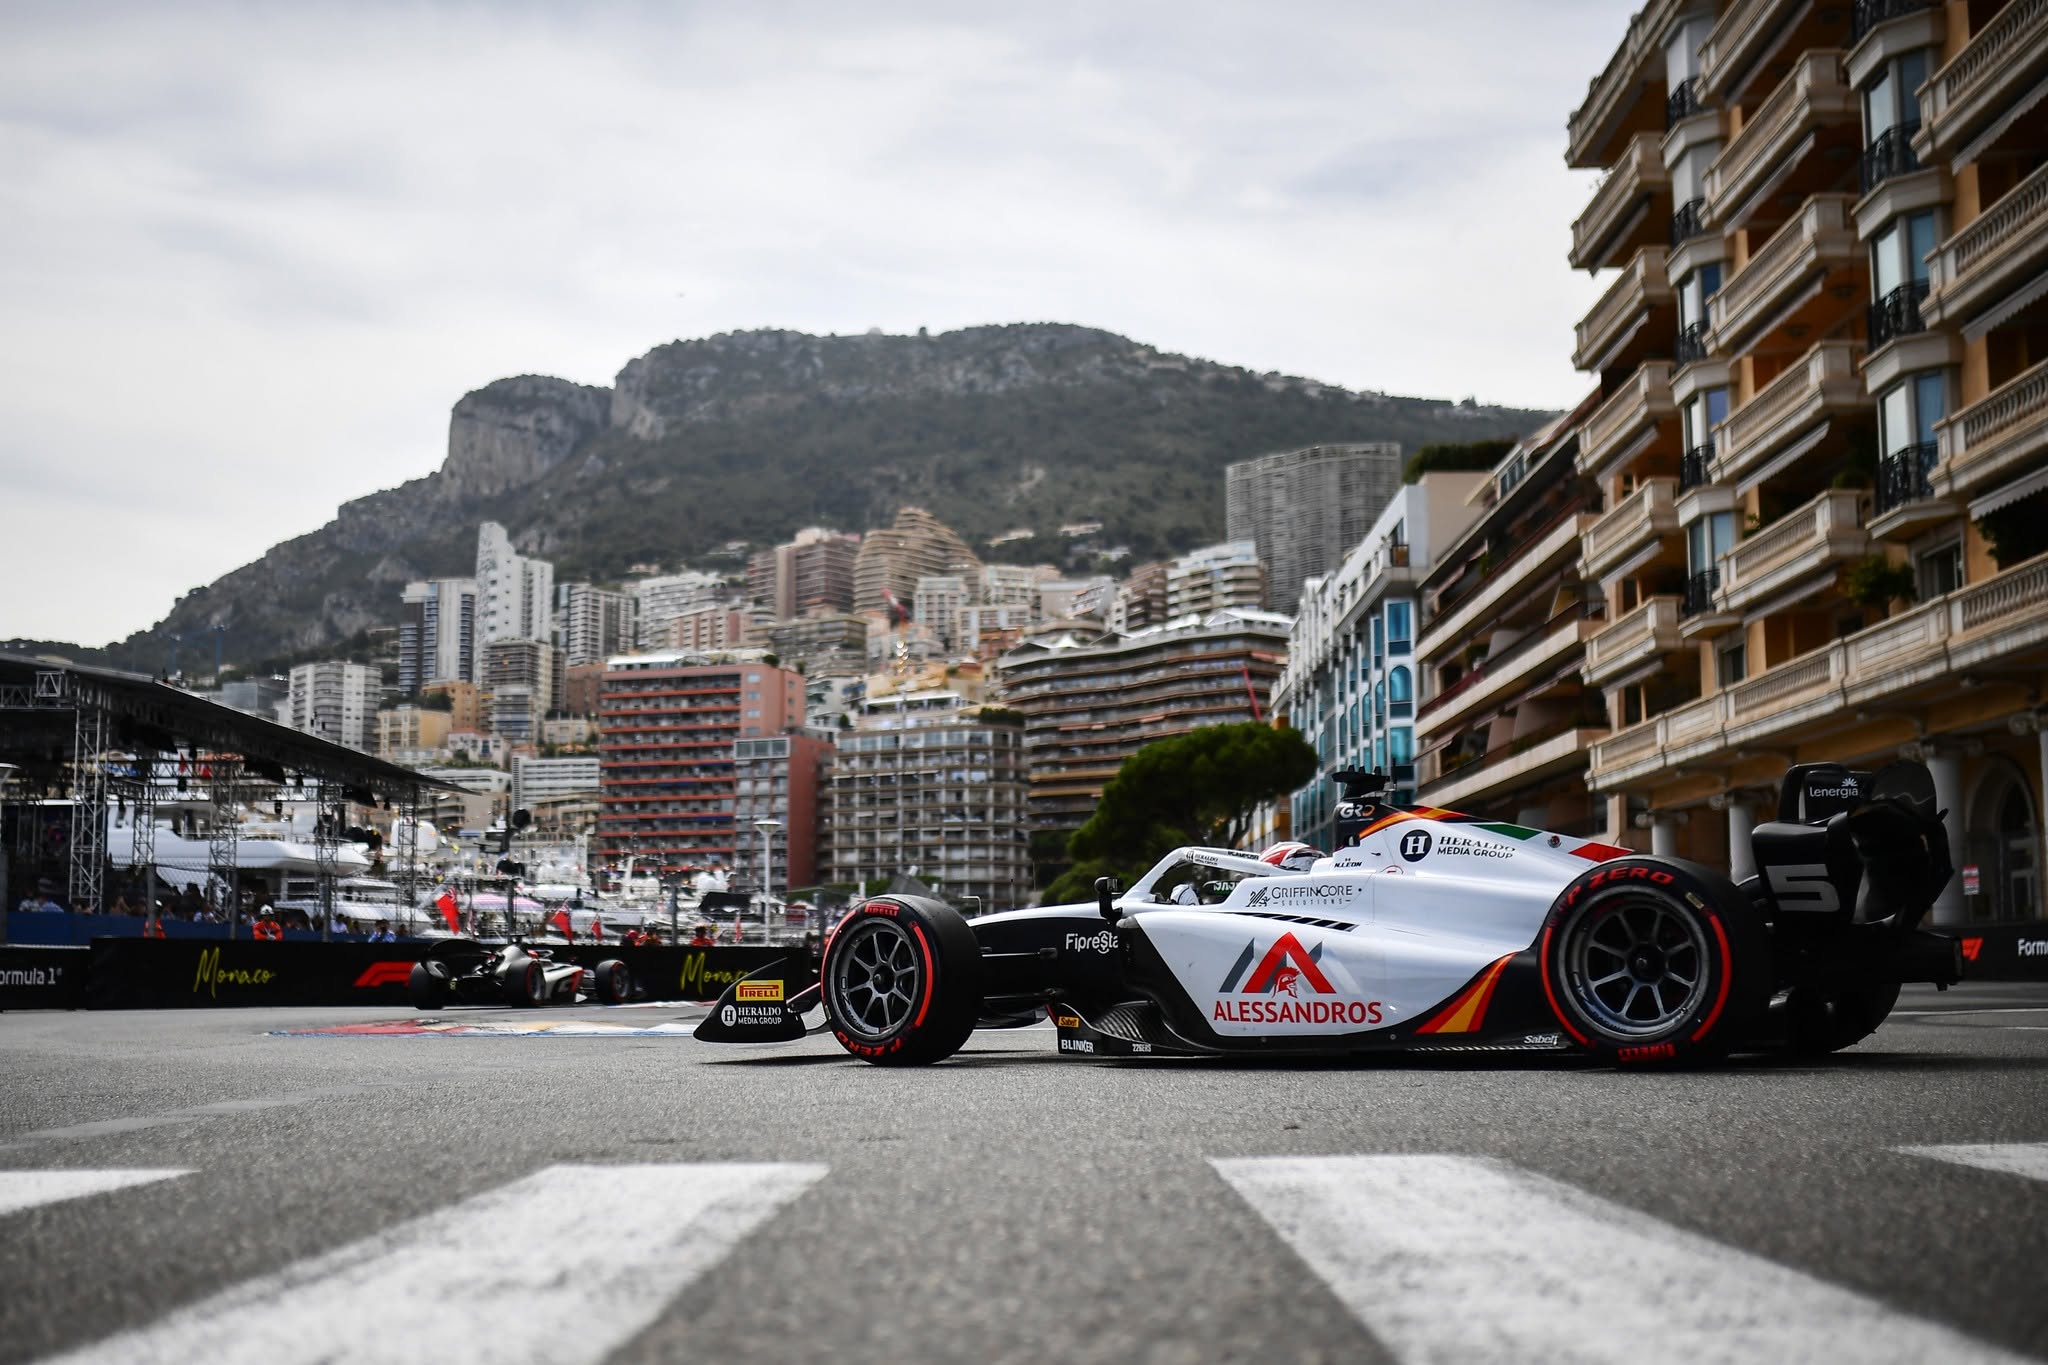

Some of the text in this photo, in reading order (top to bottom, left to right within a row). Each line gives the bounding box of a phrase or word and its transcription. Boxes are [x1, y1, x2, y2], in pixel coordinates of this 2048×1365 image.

[1440, 836, 1516, 851] HERALDO
[1437, 846, 1514, 859] MEDIA GROUP
[1589, 866, 1675, 889] ZERO
[1765, 863, 1841, 912] 5
[864, 902, 900, 917] PIRELLI
[2017, 938, 2048, 956] Form
[0, 967, 45, 985] ormula
[193, 946, 276, 999] Monaco
[681, 952, 750, 995] Monac
[739, 984, 780, 998] PIRELLI
[738, 1007, 782, 1016] HERALDO
[1213, 1001, 1383, 1024] ALESSANDROS
[738, 1017, 782, 1025] MEDIA GROUP
[1061, 1040, 1094, 1053] BLINKER
